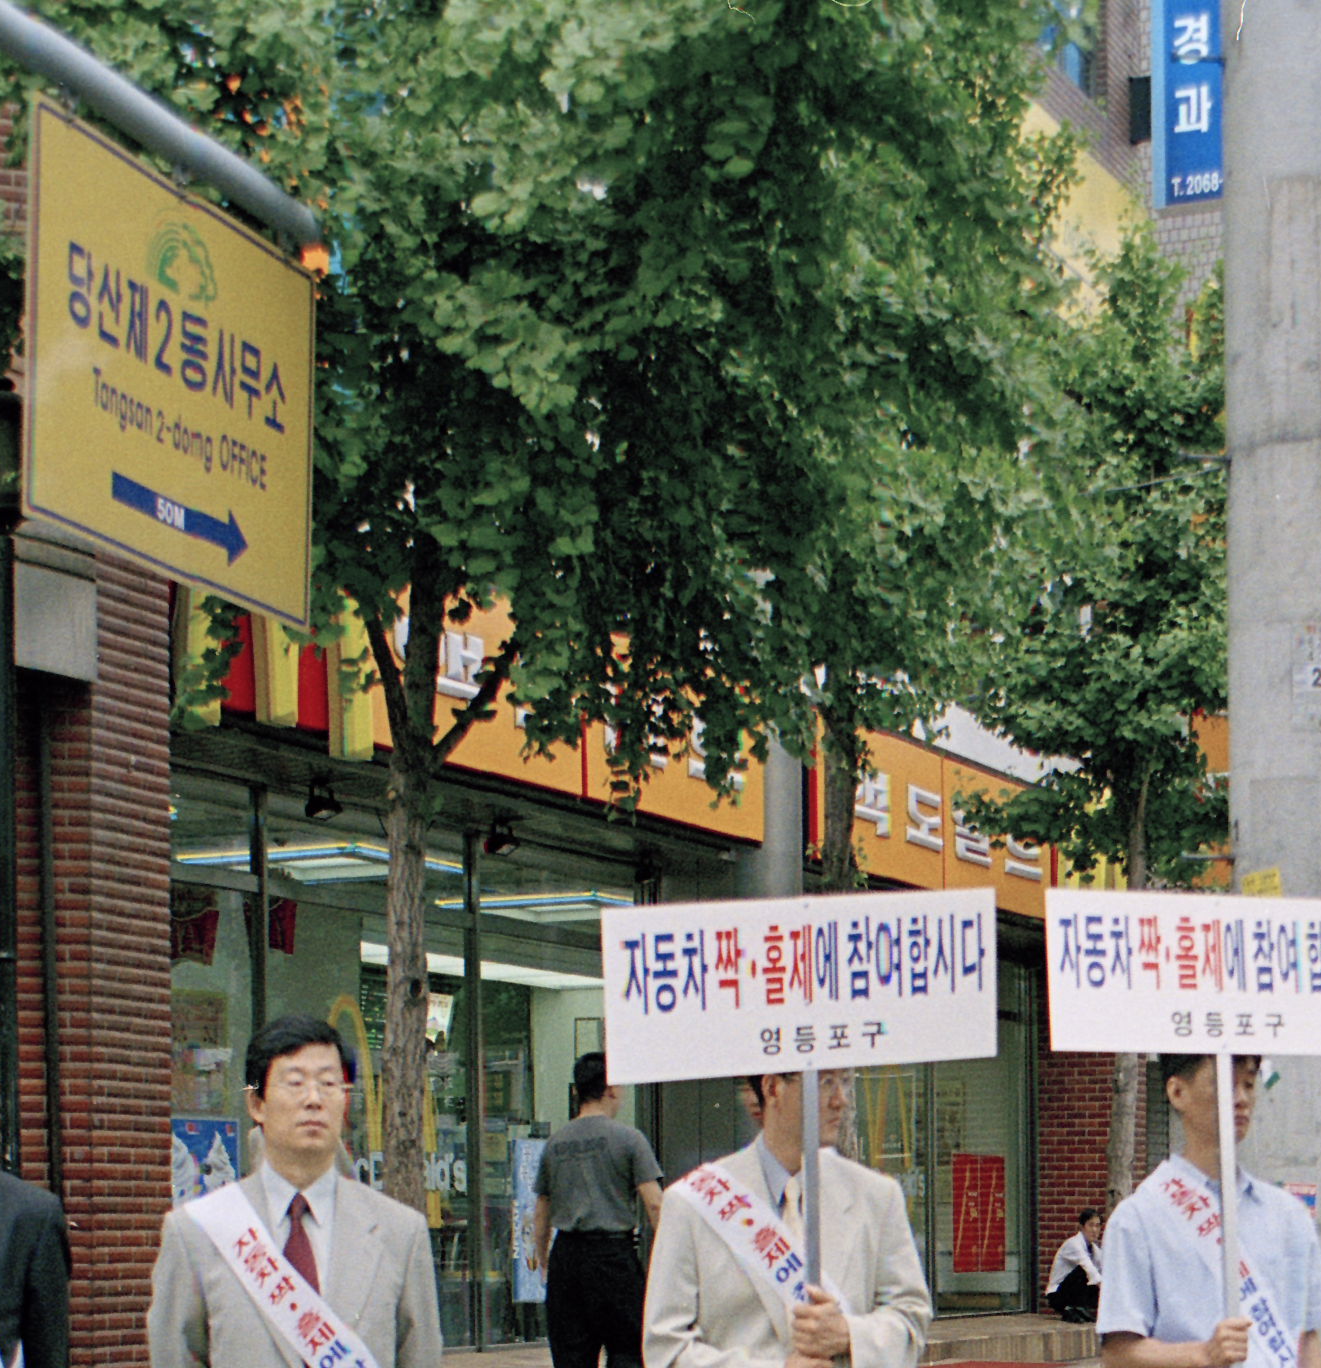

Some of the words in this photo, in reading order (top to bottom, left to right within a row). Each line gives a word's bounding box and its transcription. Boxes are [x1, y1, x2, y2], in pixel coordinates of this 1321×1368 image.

[93, 366, 153, 432] Tangsan
[220, 434, 267, 491] OFFICE
[156, 497, 185, 530] 50M
[623, 928, 708, 1015] 자동차
[847, 912, 985, 1001] 참여합시다
[1059, 913, 1132, 990] 자동차
[760, 1021, 884, 1056] 영등포구
[1171, 1010, 1286, 1038] 영등포구
